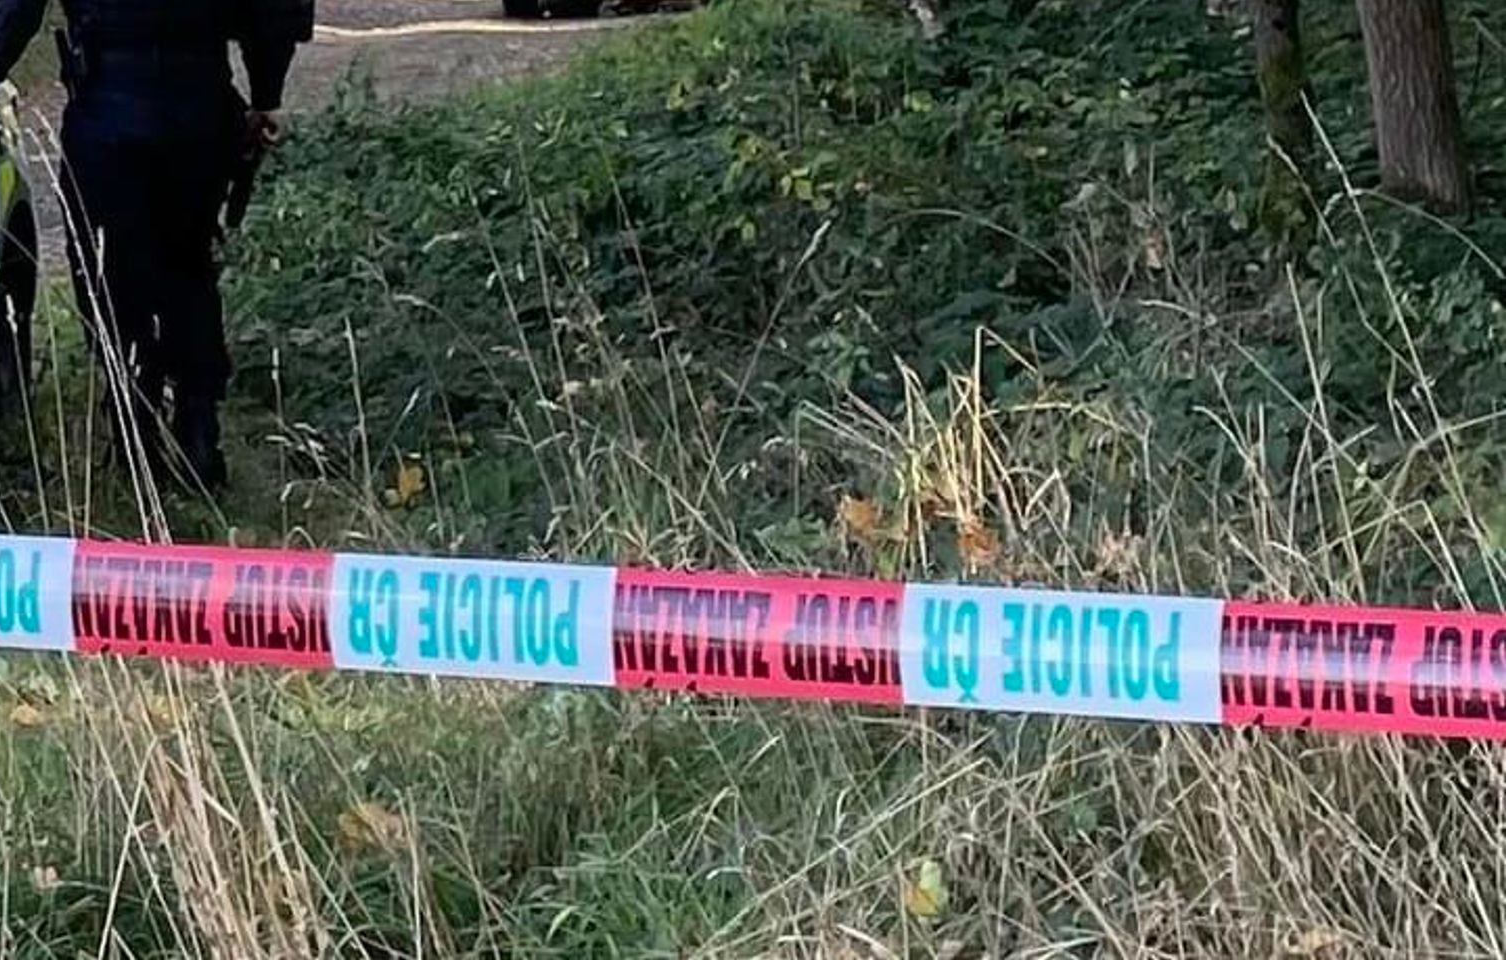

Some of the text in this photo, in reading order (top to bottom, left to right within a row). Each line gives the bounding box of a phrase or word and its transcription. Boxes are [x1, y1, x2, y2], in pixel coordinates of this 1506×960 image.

[71, 556, 332, 655] VSTUP ZAKÁZÁN
[348, 568, 580, 669] POLICIE ČR
[615, 583, 903, 692] VSTUP ZAKÁZÁN
[924, 598, 1182, 704] POLICIE ČR
[1222, 615, 1506, 728] STUP ZAKÁZÁN
